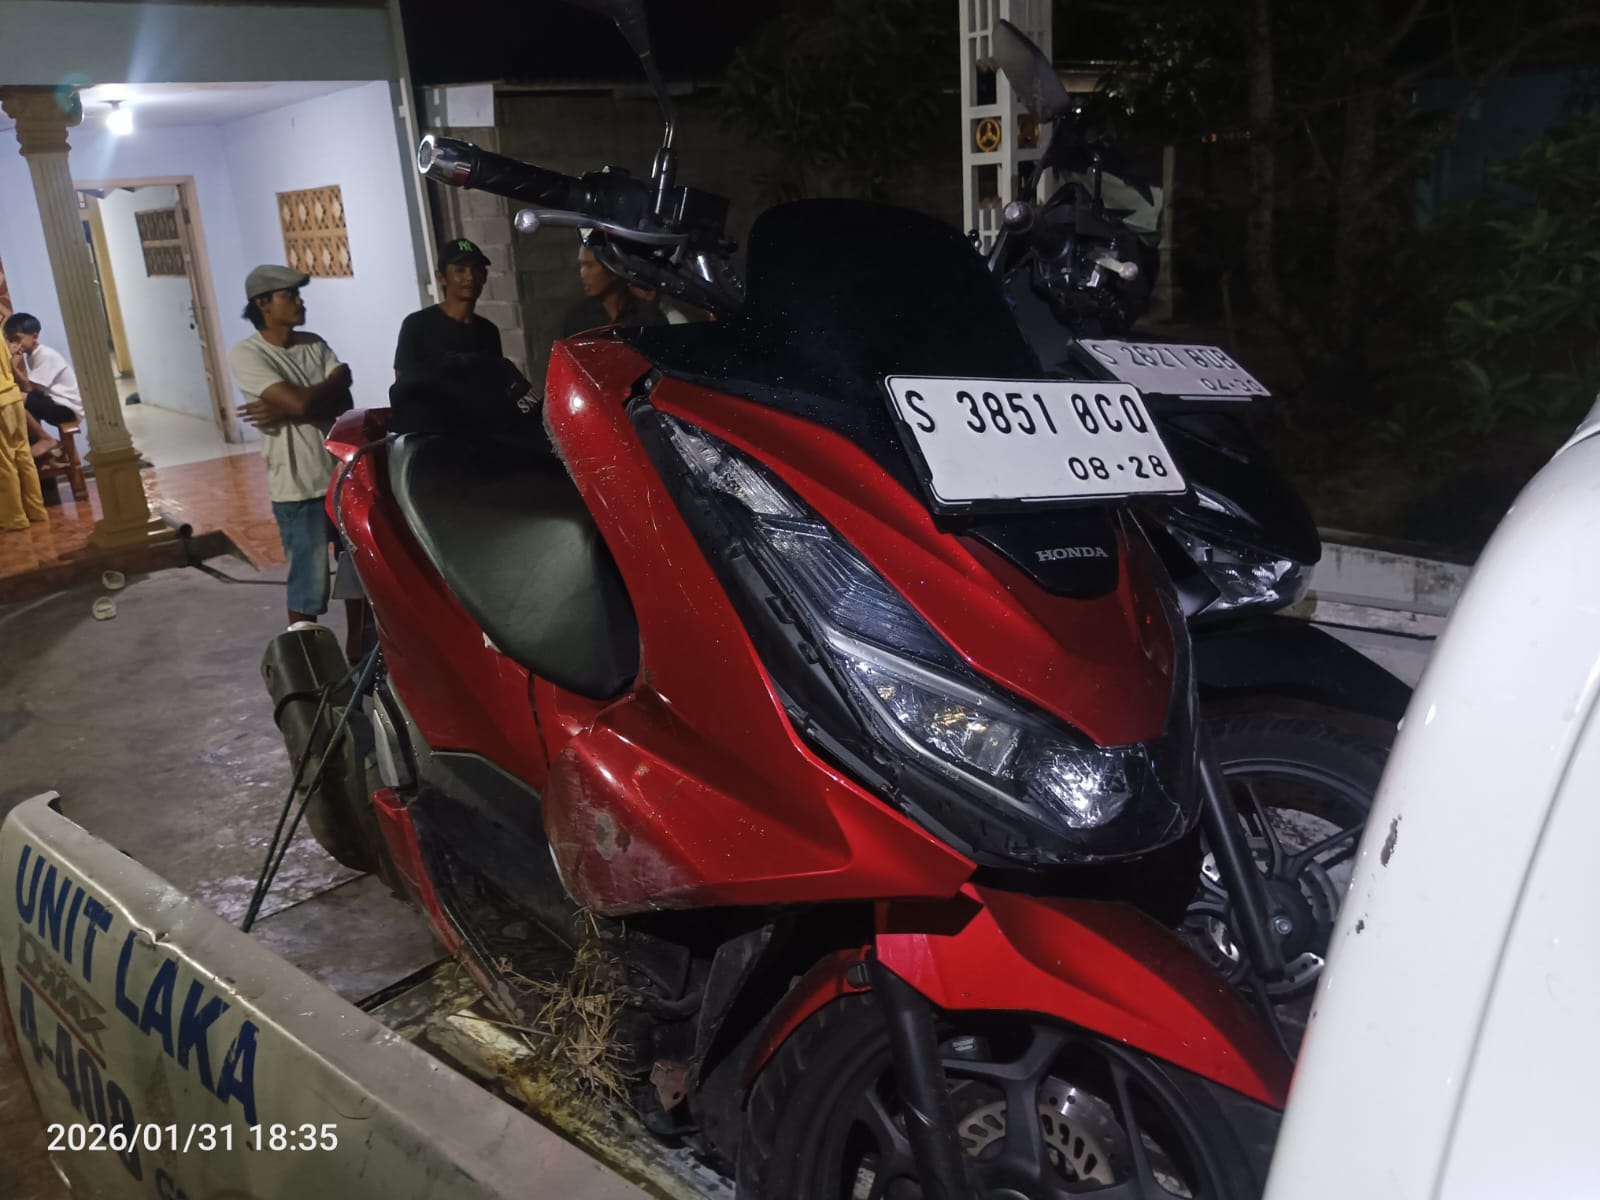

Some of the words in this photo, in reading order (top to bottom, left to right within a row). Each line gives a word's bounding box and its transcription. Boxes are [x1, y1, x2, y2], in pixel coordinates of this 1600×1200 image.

[1091, 344, 1118, 365] S
[1120, 345, 1187, 369] 2621
[904, 389, 936, 433] S
[956, 390, 1058, 435] 3851
[1035, 546, 1109, 561] HONDA
[16, 844, 113, 982] UNIT
[115, 931, 260, 1126] LAKA
